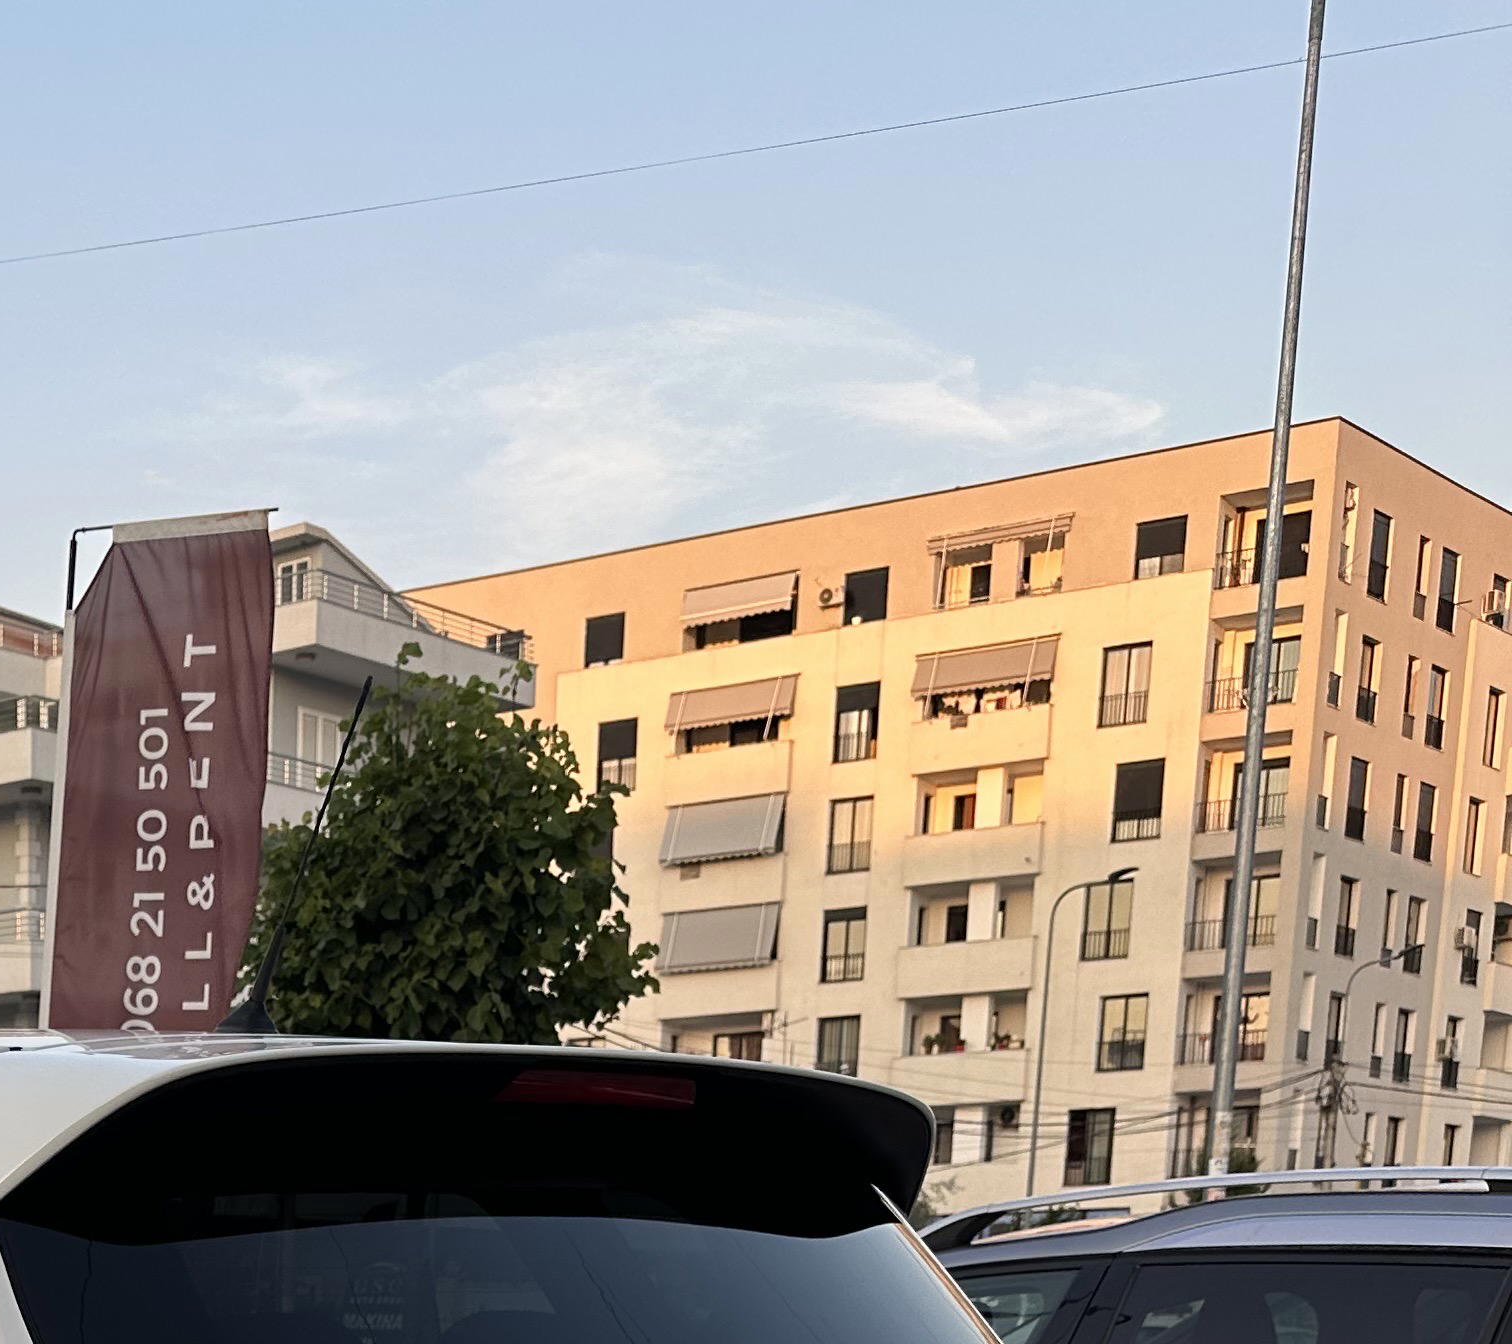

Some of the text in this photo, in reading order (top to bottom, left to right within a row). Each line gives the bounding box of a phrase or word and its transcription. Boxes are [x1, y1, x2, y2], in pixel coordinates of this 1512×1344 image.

[137, 707, 170, 791] 501
[136, 809, 169, 873] 50
[129, 891, 165, 939] 21
